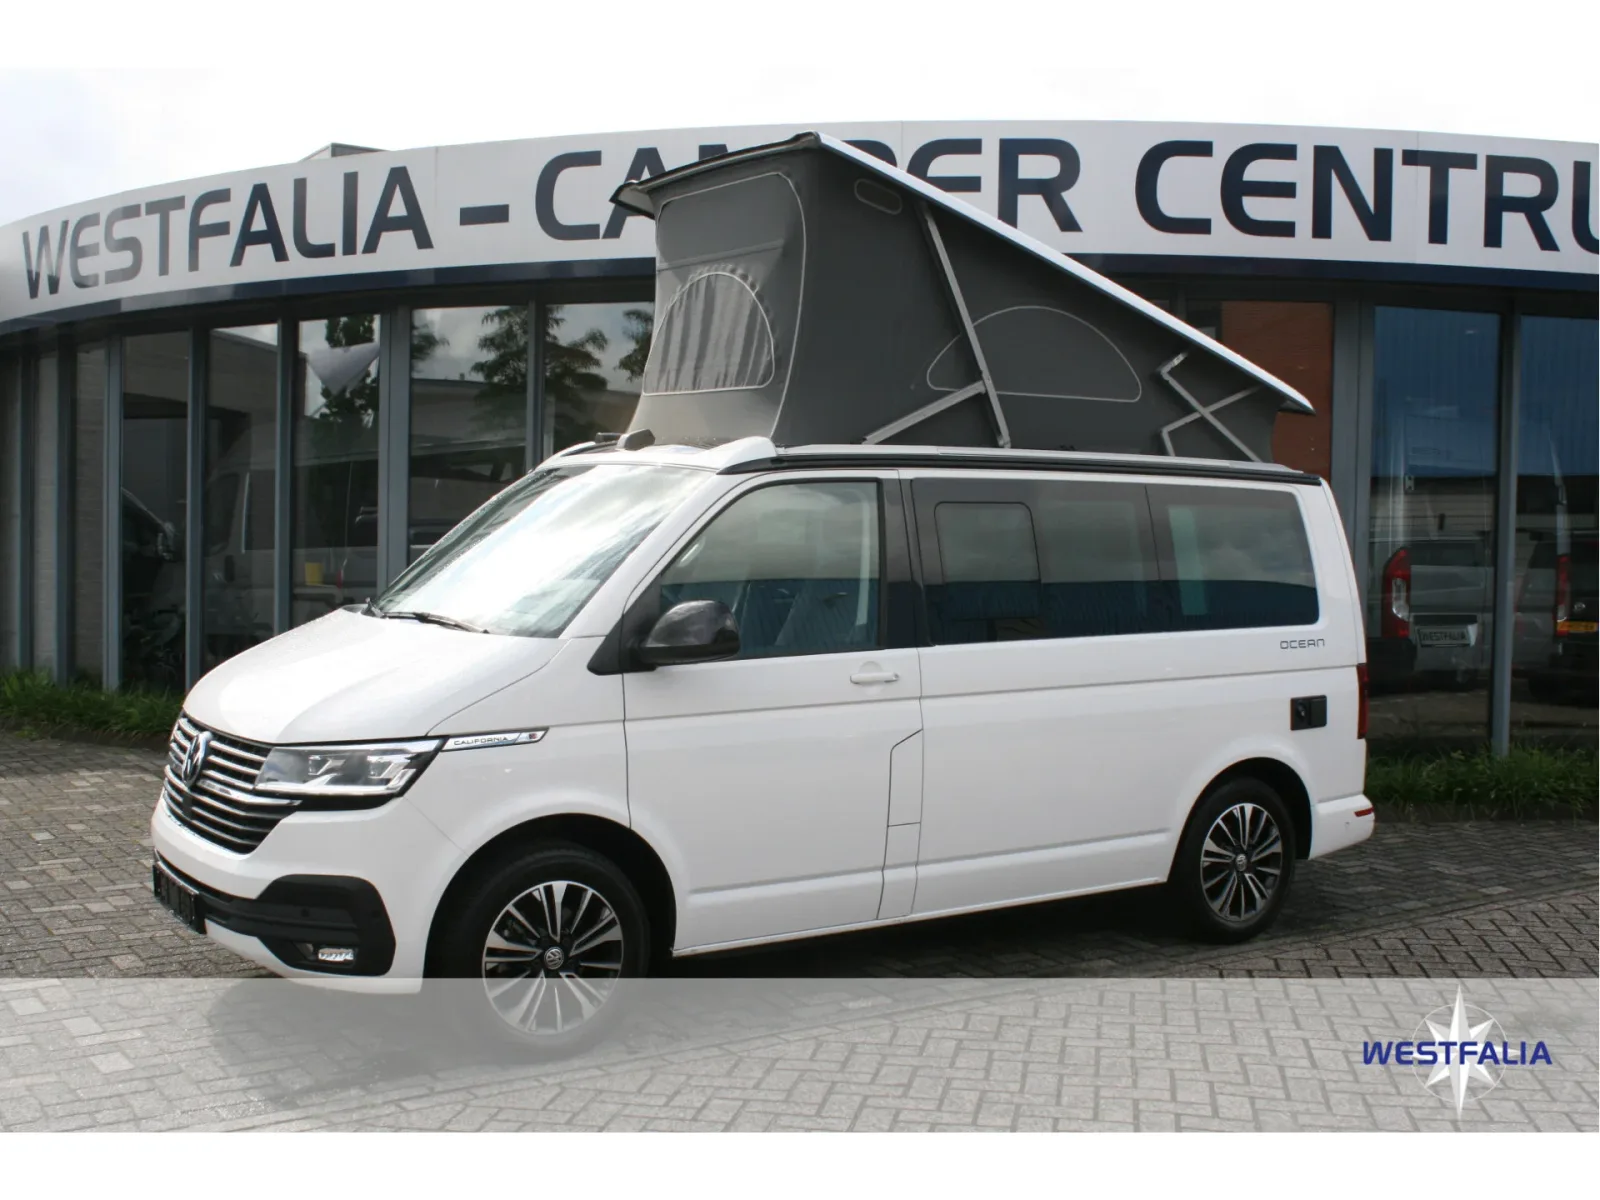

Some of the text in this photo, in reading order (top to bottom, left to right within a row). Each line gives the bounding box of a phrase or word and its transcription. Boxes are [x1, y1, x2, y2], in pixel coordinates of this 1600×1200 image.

[22, 166, 434, 299] WESTFALIA
[535, 138, 1083, 241] CAER
[1280, 638, 1325, 650] OCEAN
[453, 736, 509, 746] CALIFORNIA
